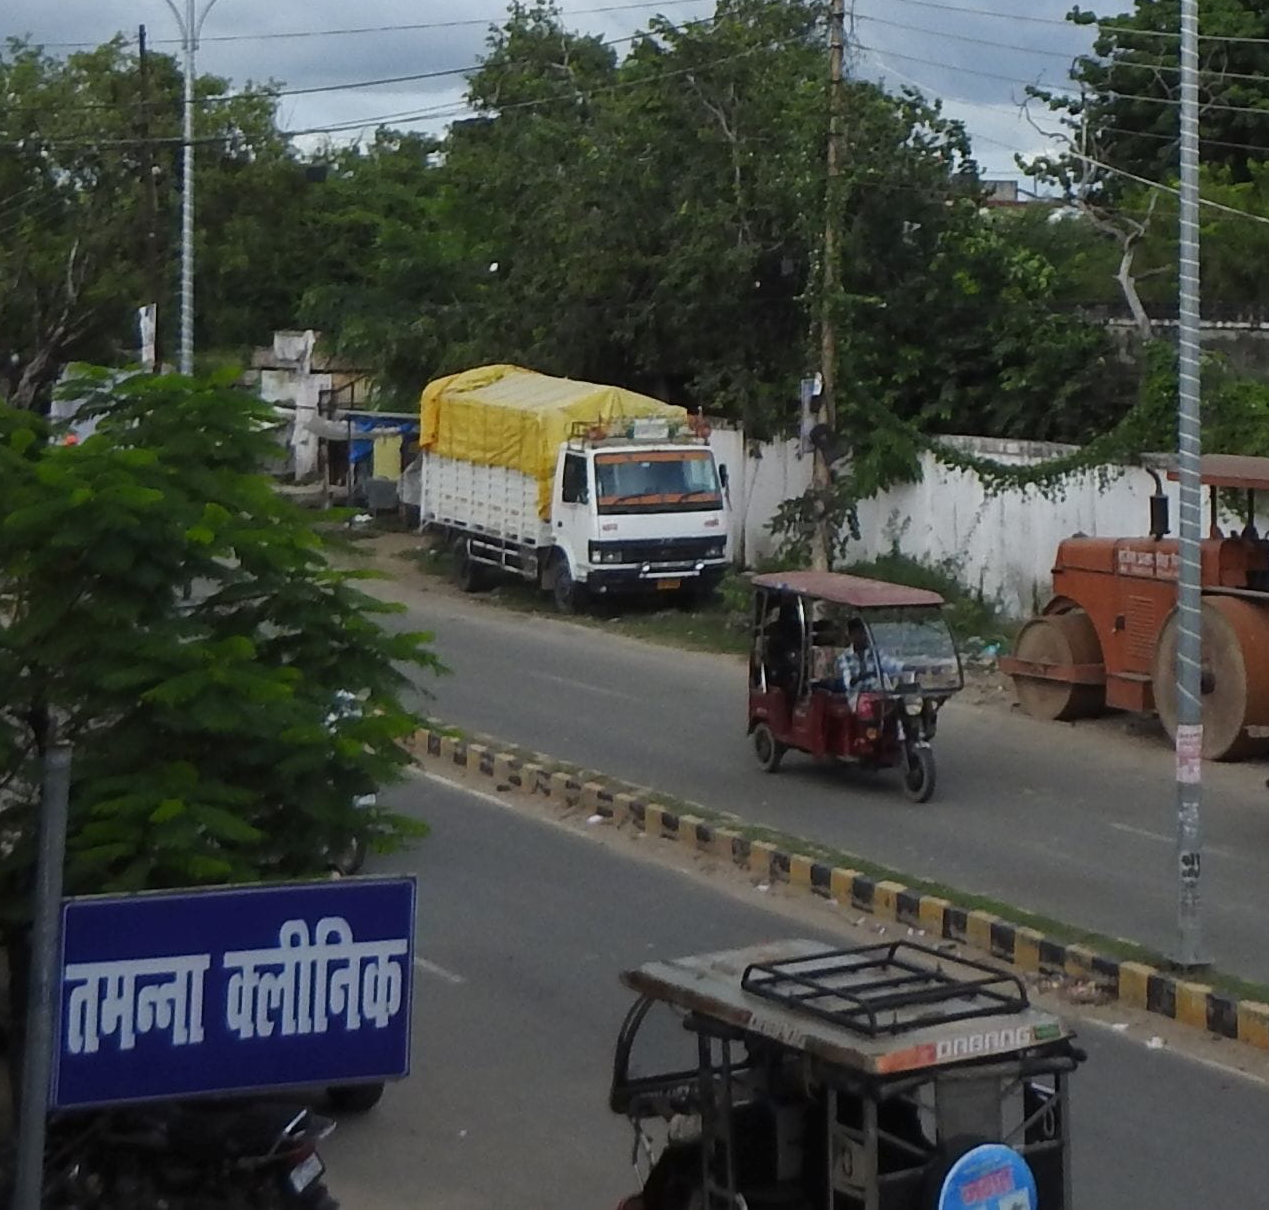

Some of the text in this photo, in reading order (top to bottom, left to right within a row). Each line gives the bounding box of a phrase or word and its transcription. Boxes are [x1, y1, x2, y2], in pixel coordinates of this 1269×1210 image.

[65, 916, 408, 1055] तमन्ना क्लीनिक
[935, 1026, 1031, 1059] DABANG
